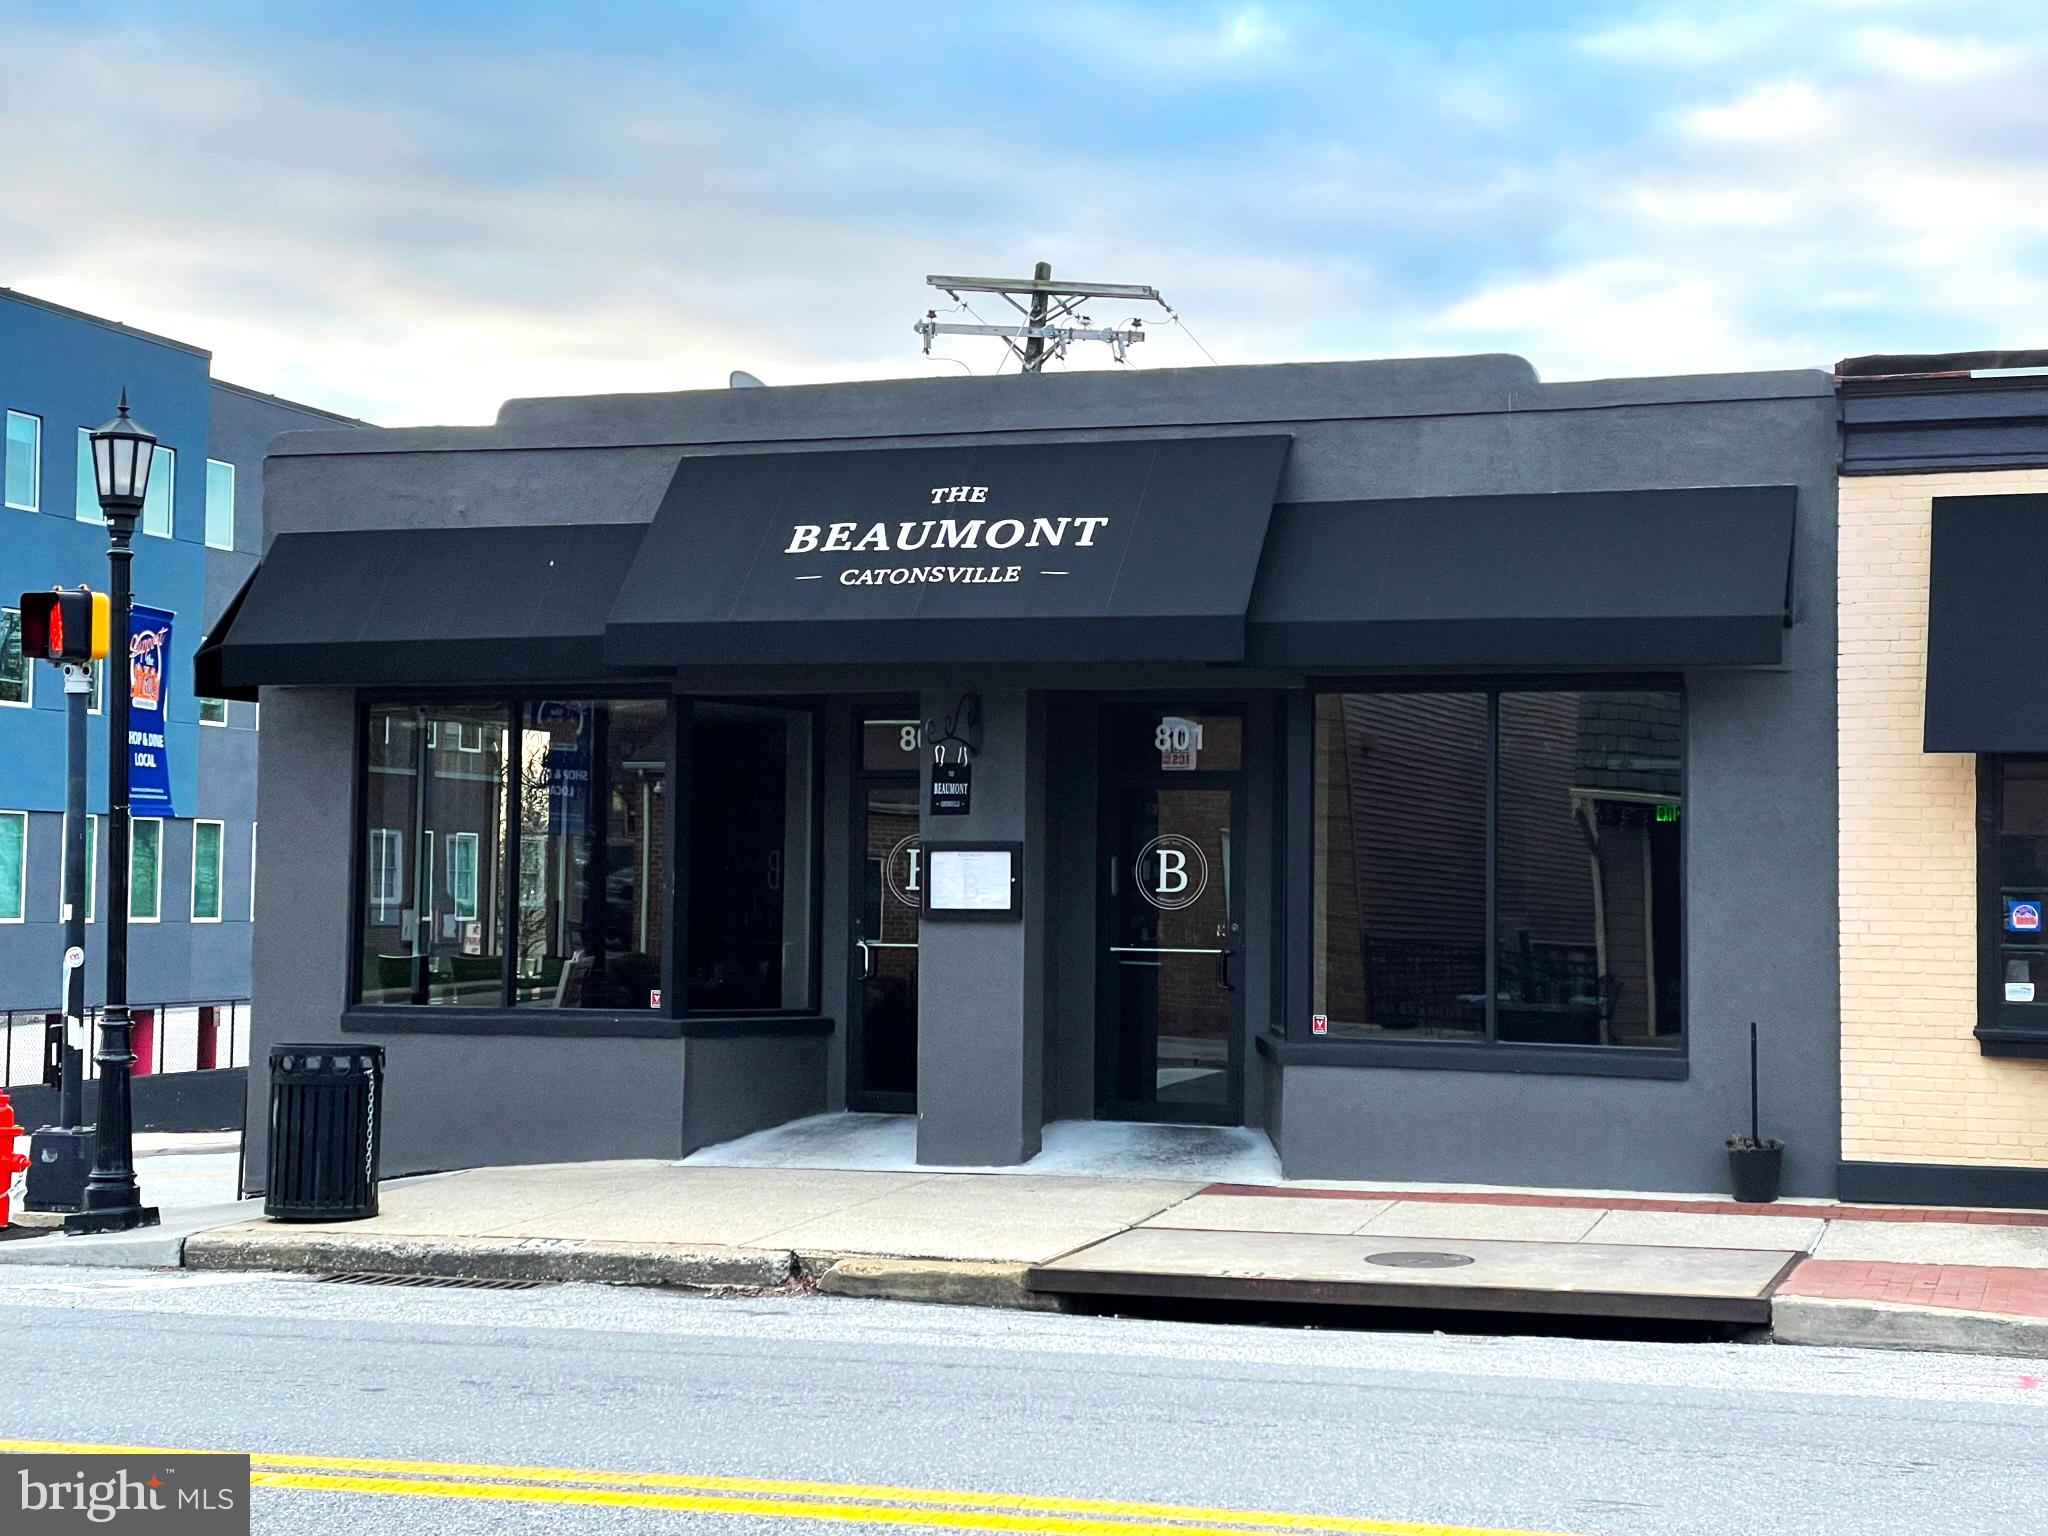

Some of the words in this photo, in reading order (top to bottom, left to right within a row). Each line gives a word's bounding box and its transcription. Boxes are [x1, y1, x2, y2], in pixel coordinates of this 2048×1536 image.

[931, 486, 989, 504] THE
[784, 517, 1109, 553] BEAUMONT
[839, 565, 1022, 586] CATONSVILLE
[128, 731, 142, 745] HOP
[900, 726, 921, 751] 8
[1155, 724, 1203, 750] 801
[134, 752, 157, 768] LOCAL
[933, 782, 968, 795] BEAUMONT
[1155, 849, 1188, 893] B
